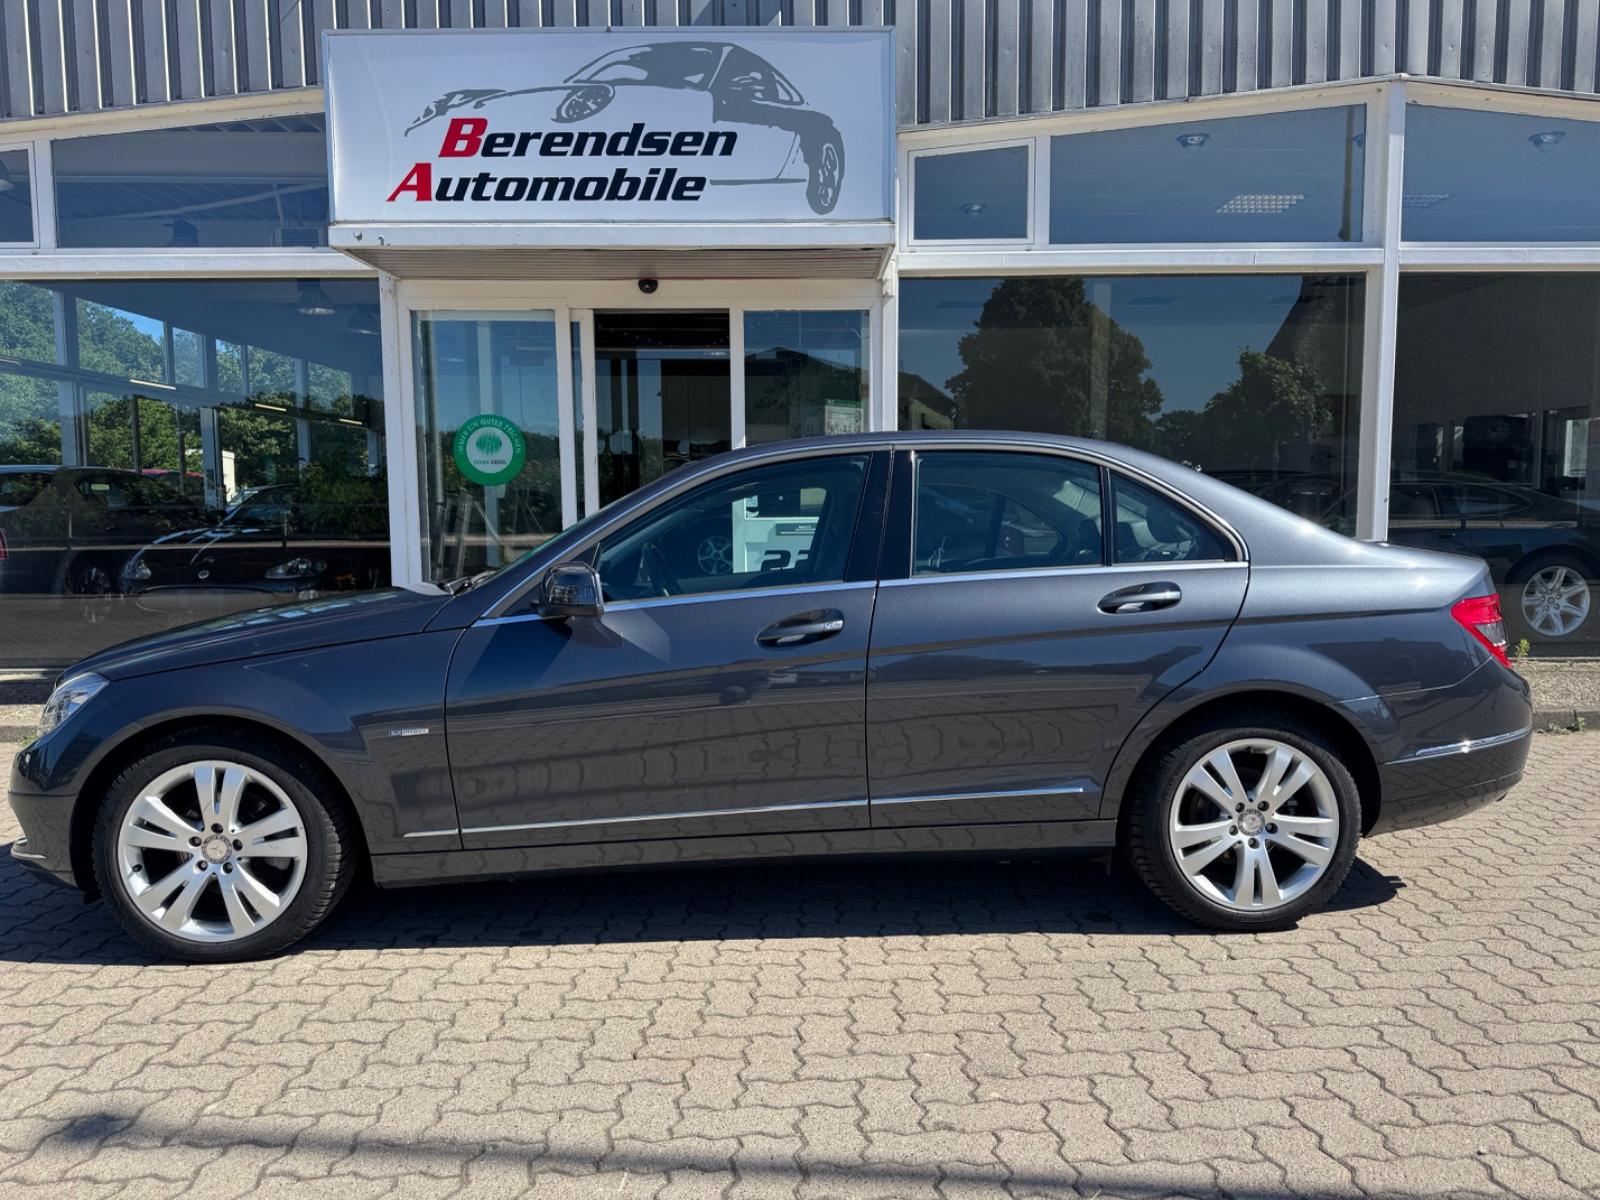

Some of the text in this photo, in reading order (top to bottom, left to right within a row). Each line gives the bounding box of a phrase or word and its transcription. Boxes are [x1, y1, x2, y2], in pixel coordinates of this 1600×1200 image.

[438, 117, 737, 158] Berendsen
[386, 162, 706, 202] Automobile
[480, 418, 503, 427] GUTES
